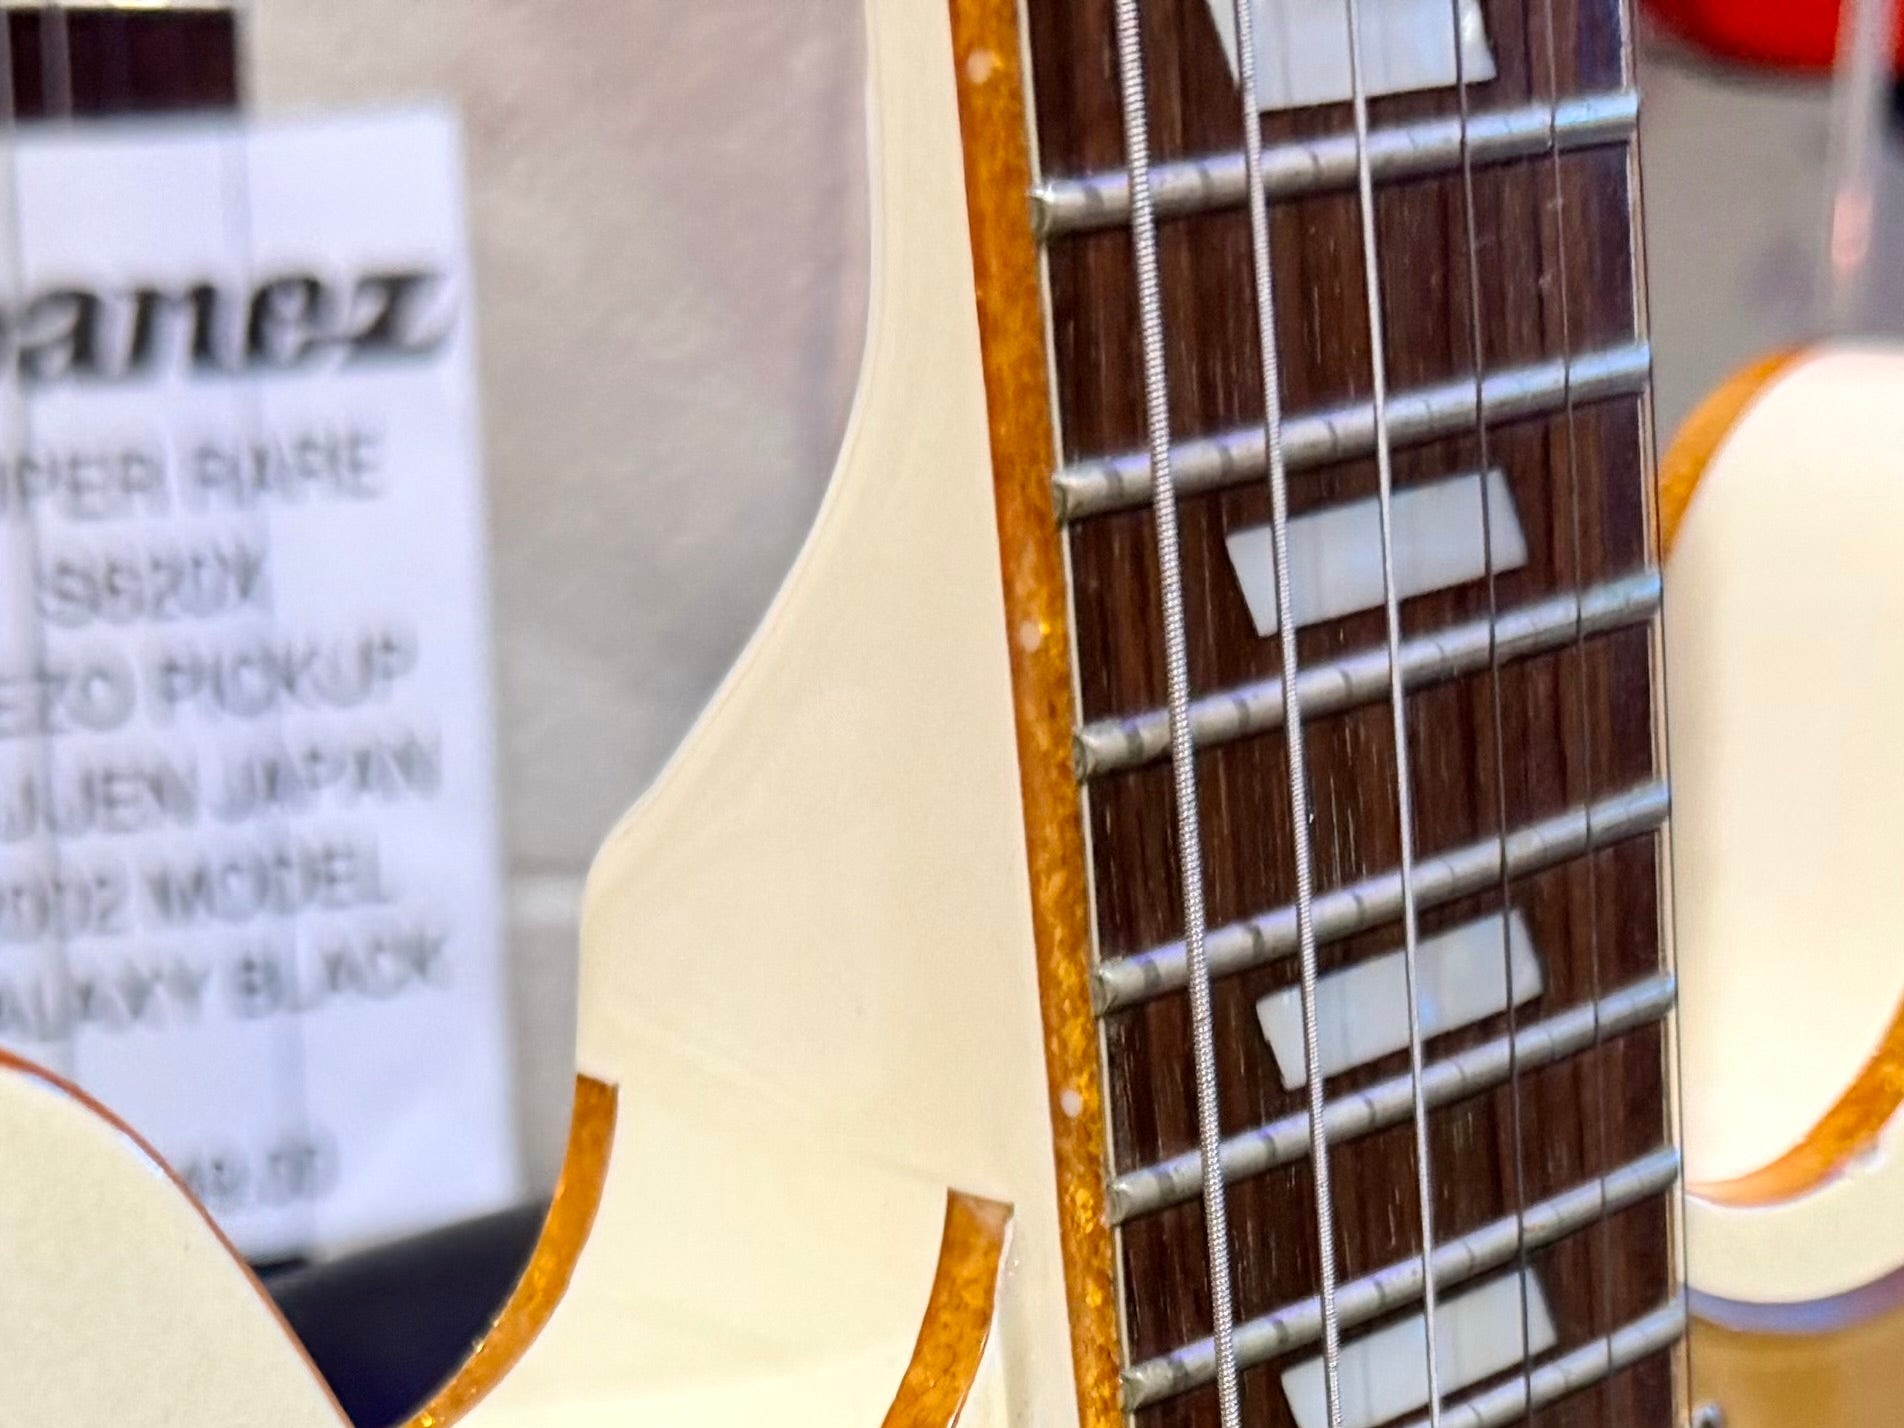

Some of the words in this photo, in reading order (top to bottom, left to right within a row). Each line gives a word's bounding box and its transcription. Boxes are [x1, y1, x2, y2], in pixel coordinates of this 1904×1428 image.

[190, 426, 388, 508] RARE
[143, 614, 419, 726] PICKUP
[207, 722, 442, 826] JAPAN
[133, 820, 396, 922] MODEL
[227, 914, 453, 1021] BLACK
